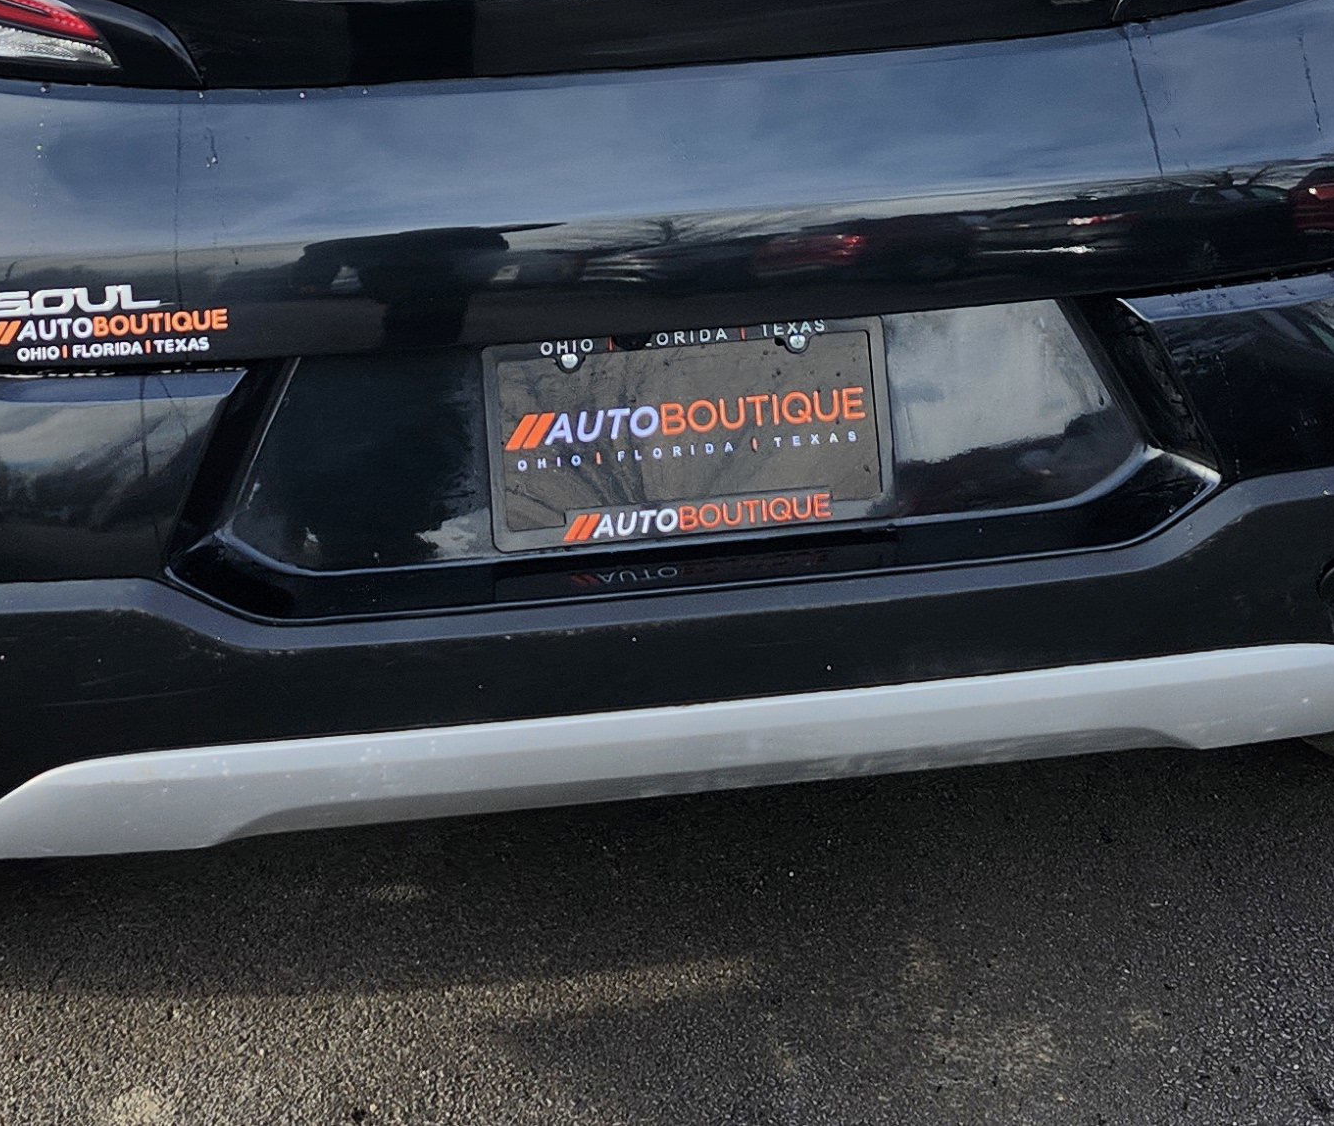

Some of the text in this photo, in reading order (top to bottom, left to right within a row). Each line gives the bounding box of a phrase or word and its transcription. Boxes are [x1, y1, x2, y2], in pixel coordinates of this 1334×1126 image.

[17, 308, 229, 342] AUTOBOUTIQUE
[16, 336, 210, 362] OHIO FLORIDA TEXAS
[540, 338, 594, 356] OHIO
[544, 386, 866, 446] AUTOBOUTIQUE
[517, 430, 857, 472] OHIO FLORIDA TEXAS
[593, 493, 832, 539] AUTOBOUTIQUE
